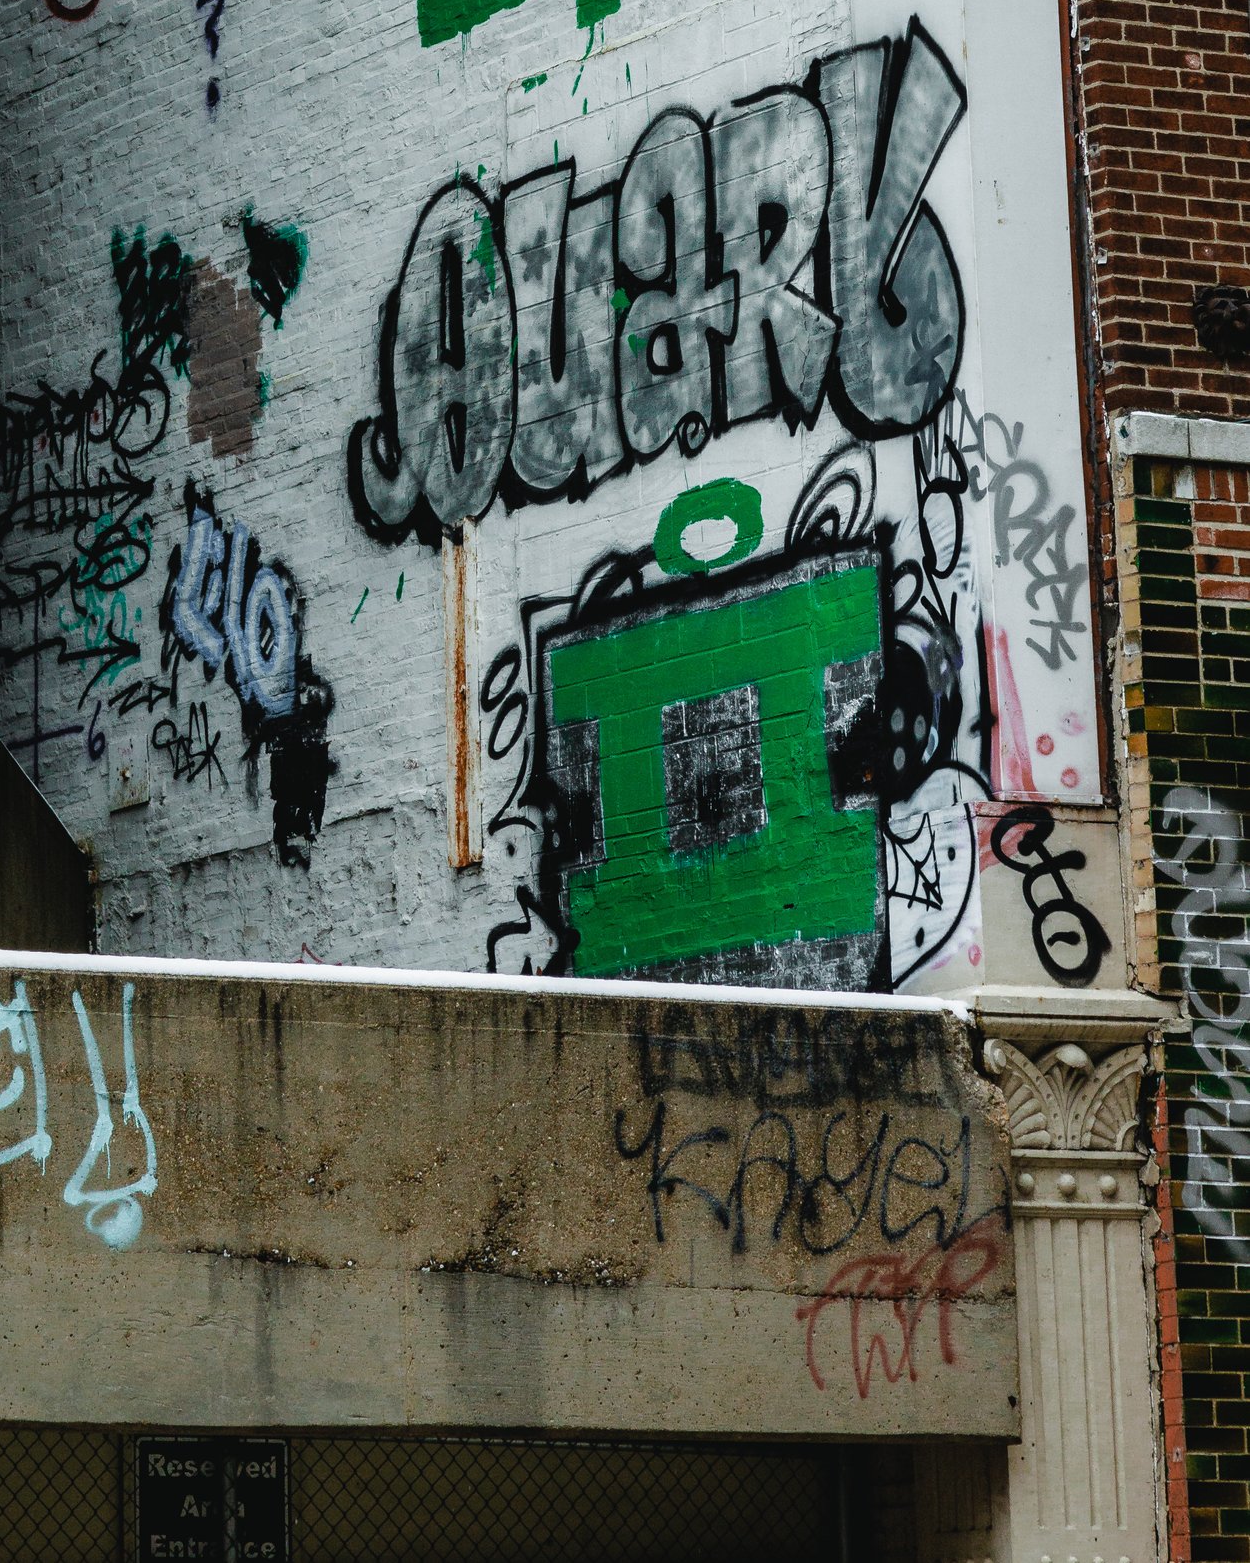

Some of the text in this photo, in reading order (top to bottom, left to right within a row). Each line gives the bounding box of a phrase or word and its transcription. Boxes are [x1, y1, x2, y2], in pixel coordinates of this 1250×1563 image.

[147, 1452, 278, 1479] Reseed
[179, 1493, 246, 1519] Ara
[149, 1533, 278, 1560] Entrace
